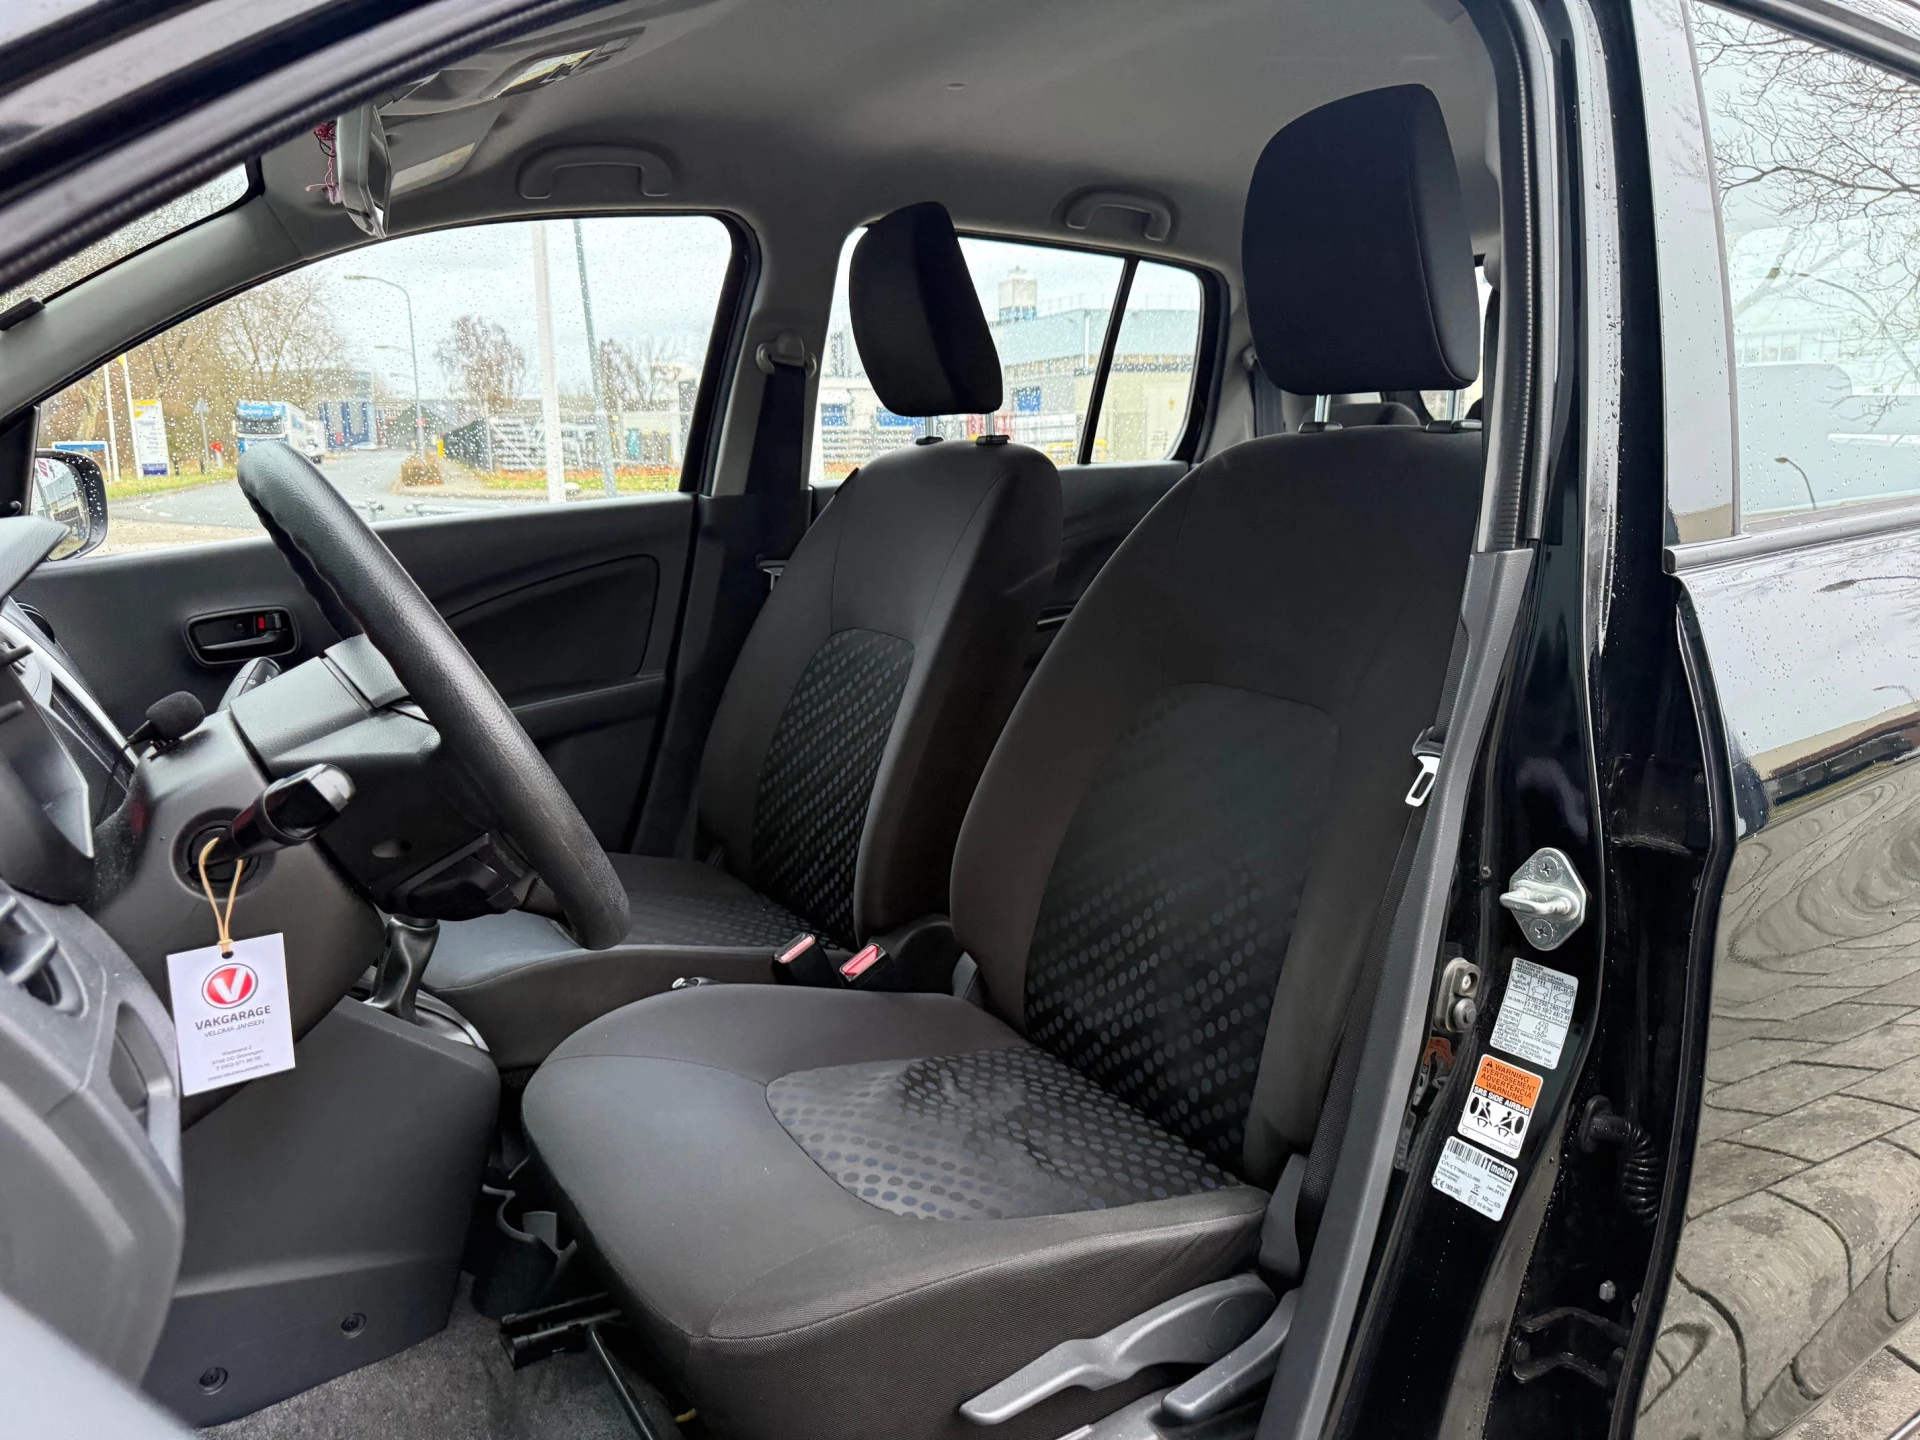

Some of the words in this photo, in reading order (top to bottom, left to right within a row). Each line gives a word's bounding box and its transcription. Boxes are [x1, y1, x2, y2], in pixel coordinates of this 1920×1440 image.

[195, 1005, 272, 1030] VAKGARAGE
[204, 1025, 235, 1038] VELDMA
[236, 1018, 265, 1031] JANSEN
[1482, 1066, 1536, 1092] AVERTISSEMENT
[1494, 1064, 1530, 1083] WARNING
[1481, 1073, 1532, 1098] ADVERTENCIA
[1486, 1082, 1524, 1102] WARNUNG
[1473, 1086, 1488, 1097] SRS
[1487, 1093, 1504, 1104] SIDE
[1504, 1100, 1530, 1115] AIRBAG
[1490, 1164, 1514, 1181] mobile
